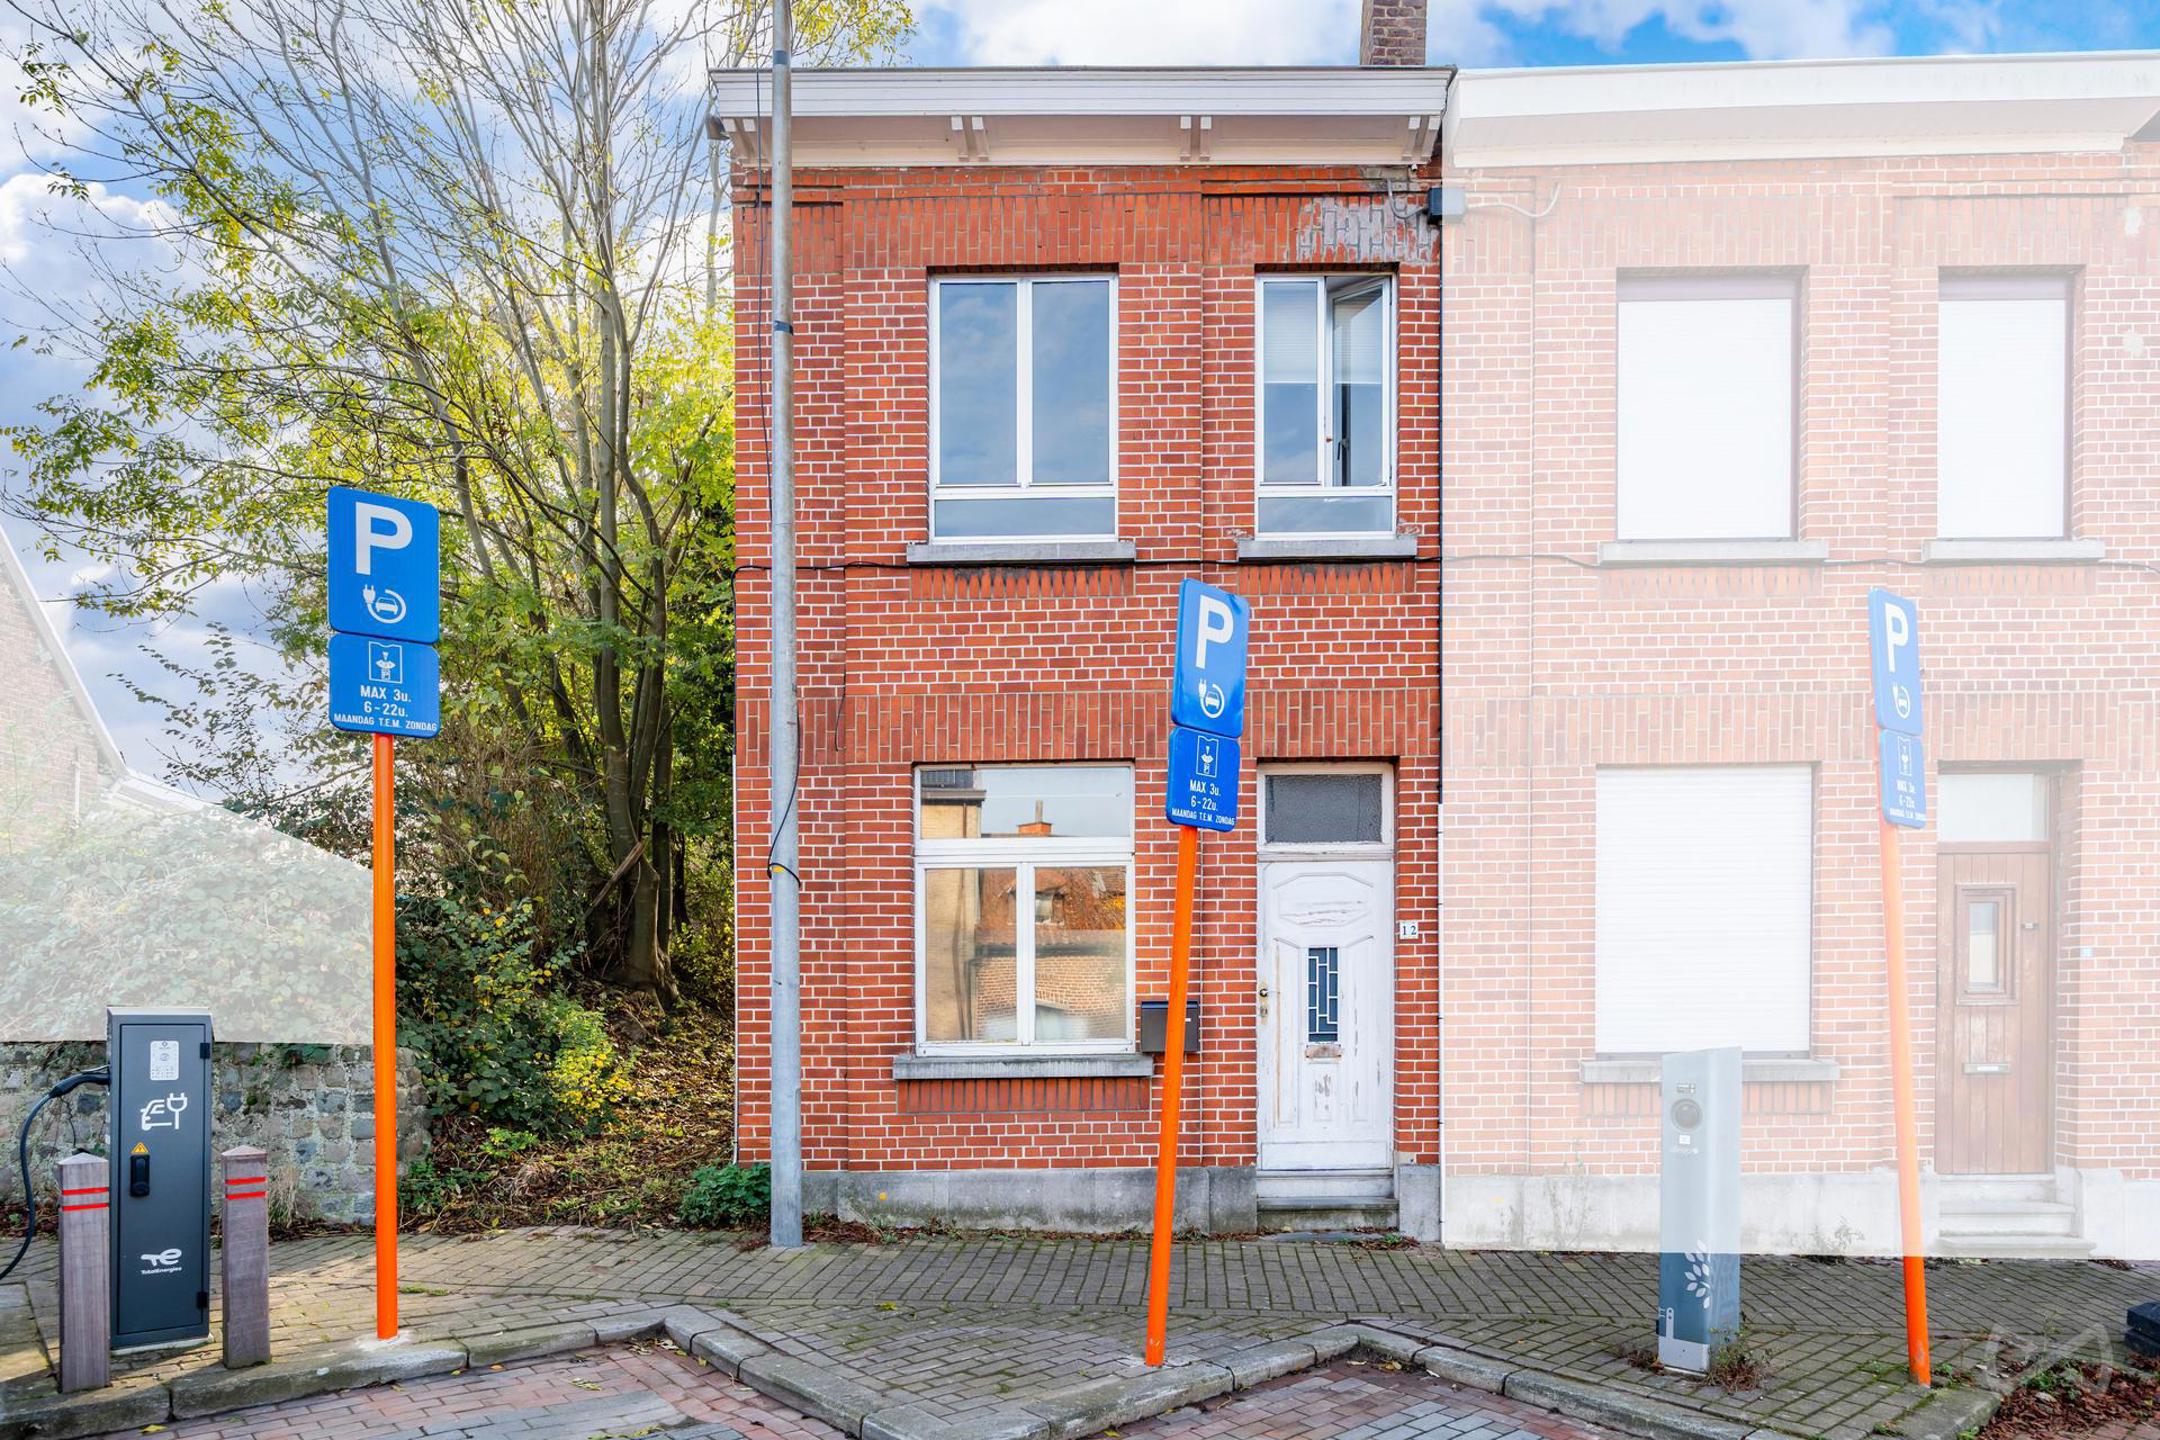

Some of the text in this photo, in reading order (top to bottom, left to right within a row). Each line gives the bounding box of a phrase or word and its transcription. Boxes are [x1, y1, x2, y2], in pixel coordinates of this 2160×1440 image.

[356, 501, 413, 576] P
[1196, 594, 1234, 669] P
[1885, 602, 1909, 673] P
[360, 685, 411, 702] MAX 3u.
[333, 713, 375, 725] MAANDAG
[405, 720, 437, 731] ZONDAG
[1190, 779, 1206, 793] MAX
[1172, 808, 1197, 819] MAANDAG
[1403, 925, 1417, 935] 12
